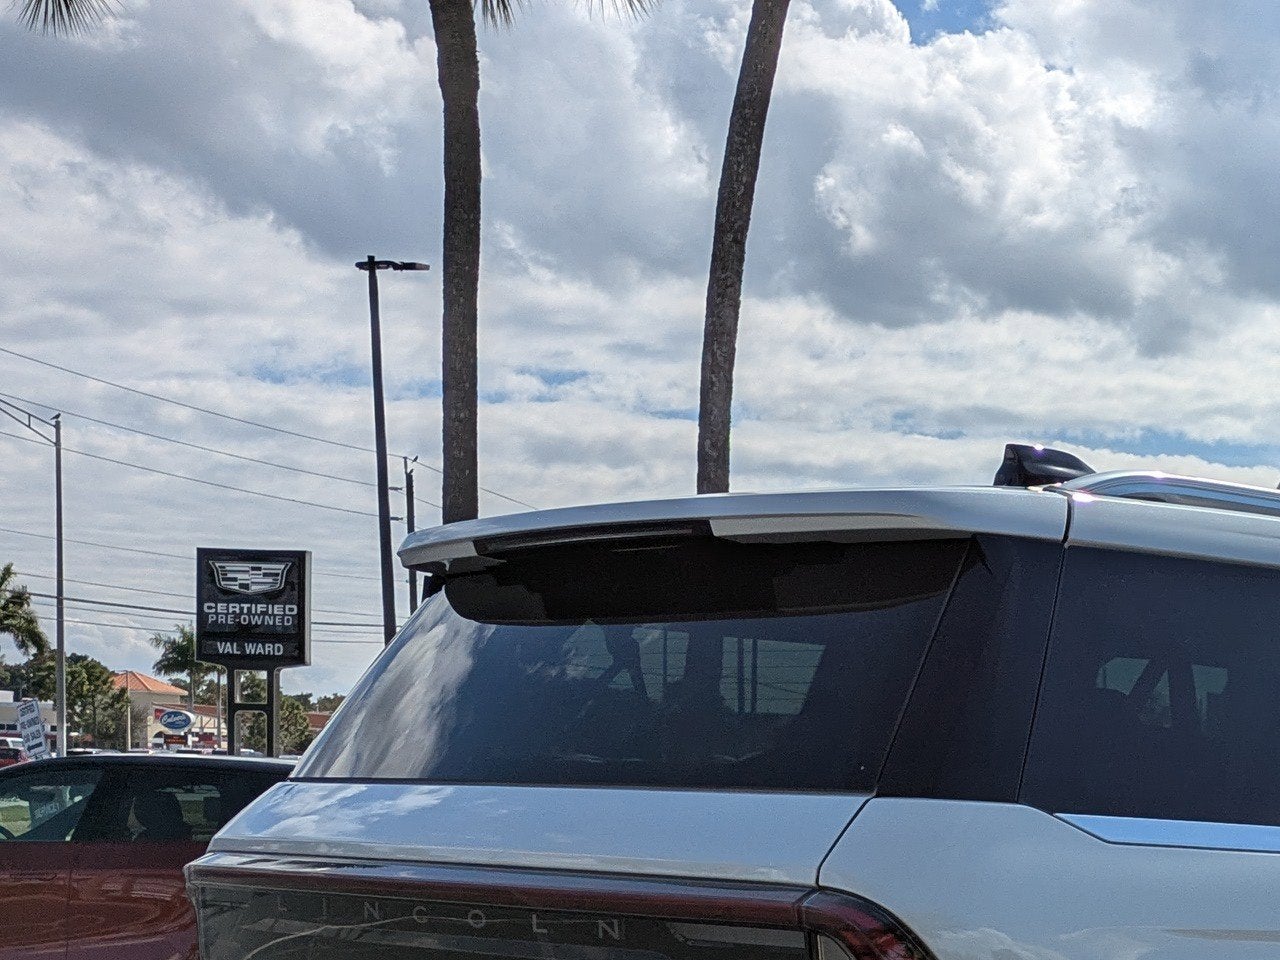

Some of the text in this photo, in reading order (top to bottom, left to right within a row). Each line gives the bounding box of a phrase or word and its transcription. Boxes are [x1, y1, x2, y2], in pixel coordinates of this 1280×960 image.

[203, 602, 298, 615] CERTIFIED
[208, 614, 293, 626] PRE-OWNED
[217, 641, 284, 656] VAL WARD
[277, 895, 622, 941] LINCOLN
